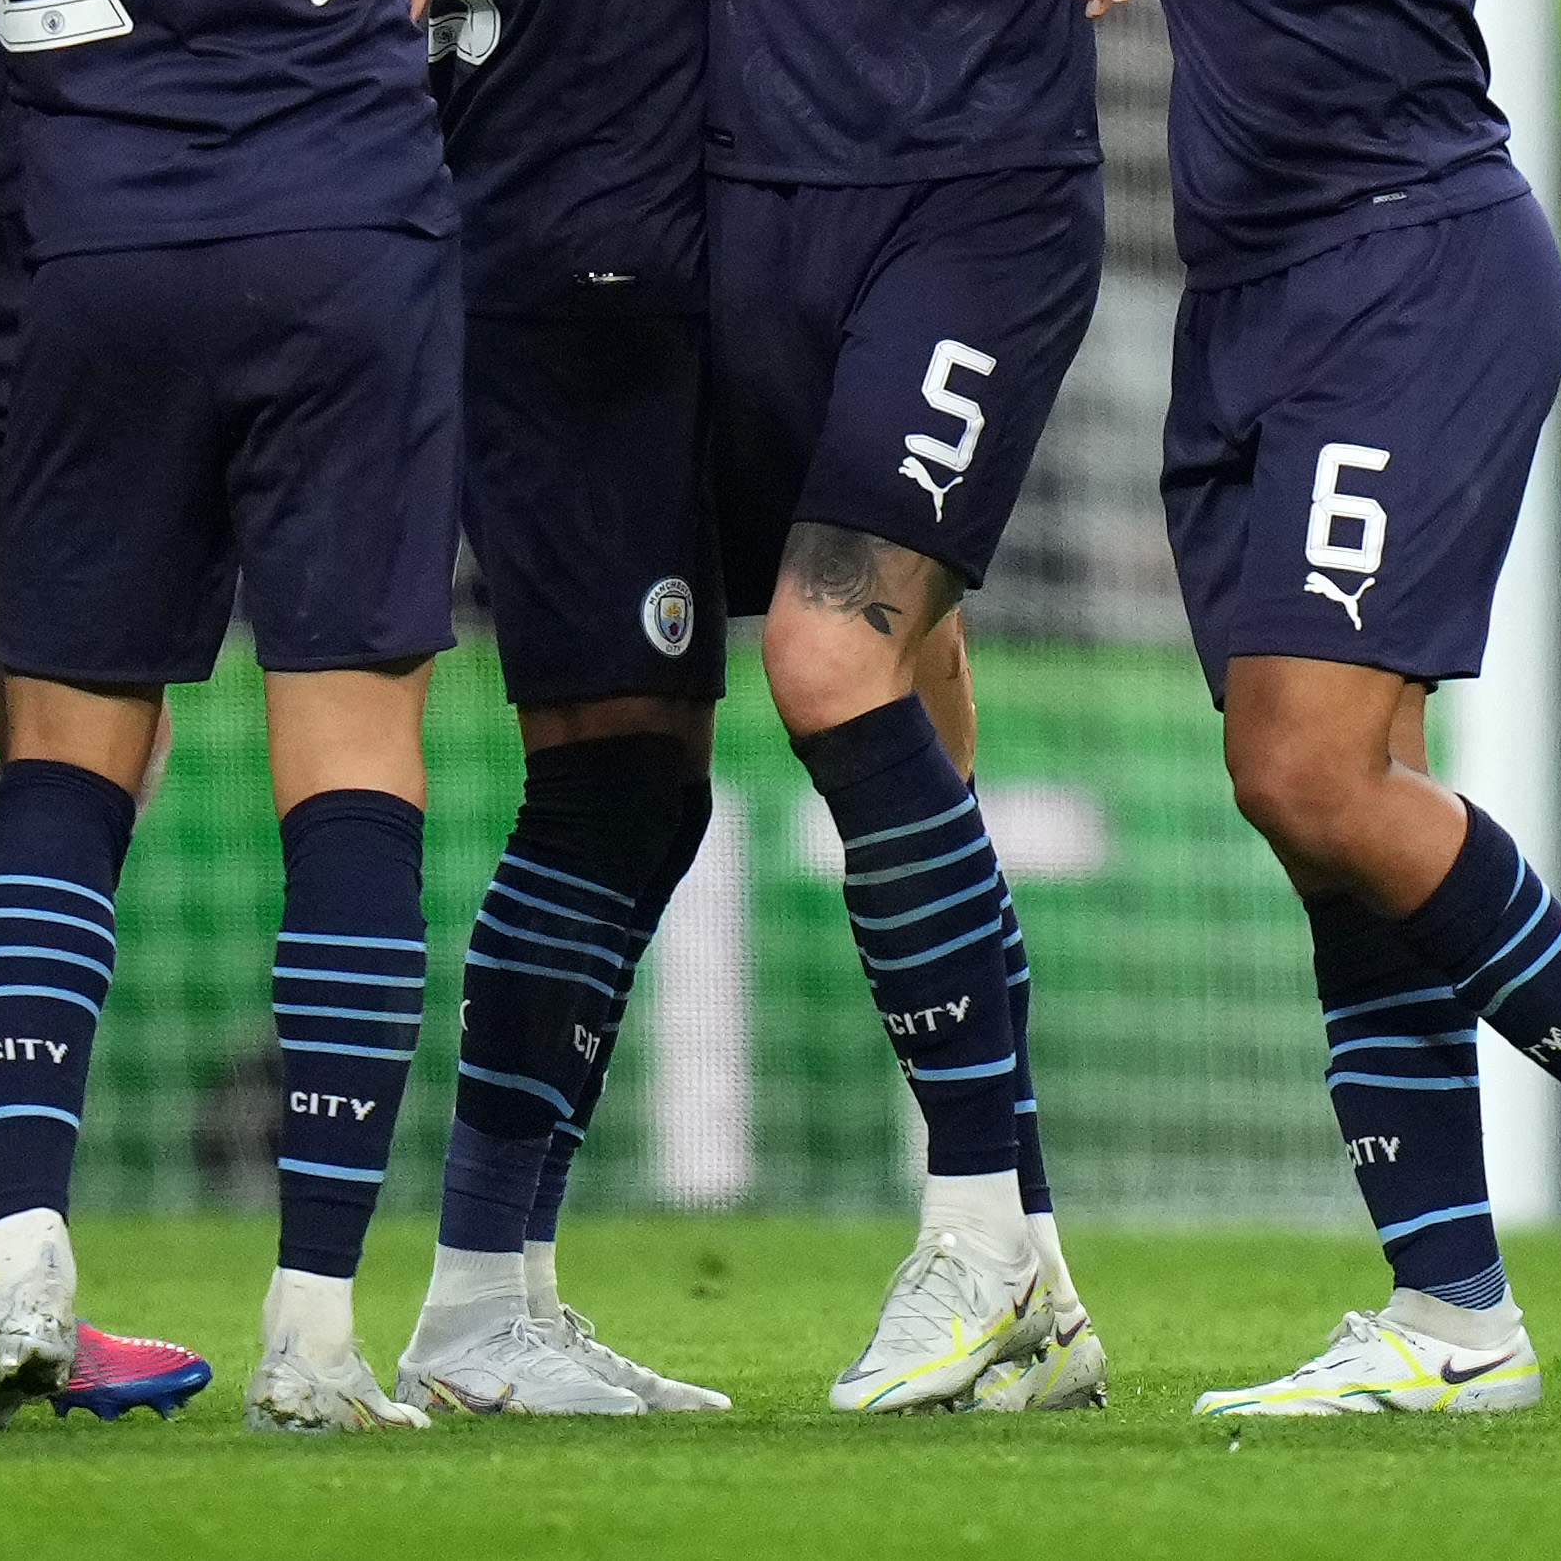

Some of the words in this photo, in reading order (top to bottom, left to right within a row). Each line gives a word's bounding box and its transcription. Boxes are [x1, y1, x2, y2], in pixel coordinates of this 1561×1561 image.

[905, 339, 997, 472] 5
[1305, 442, 1391, 574] 6
[888, 995, 972, 1036] CITY
[574, 1024, 601, 1064] CIT
[290, 1091, 376, 1121] CITY
